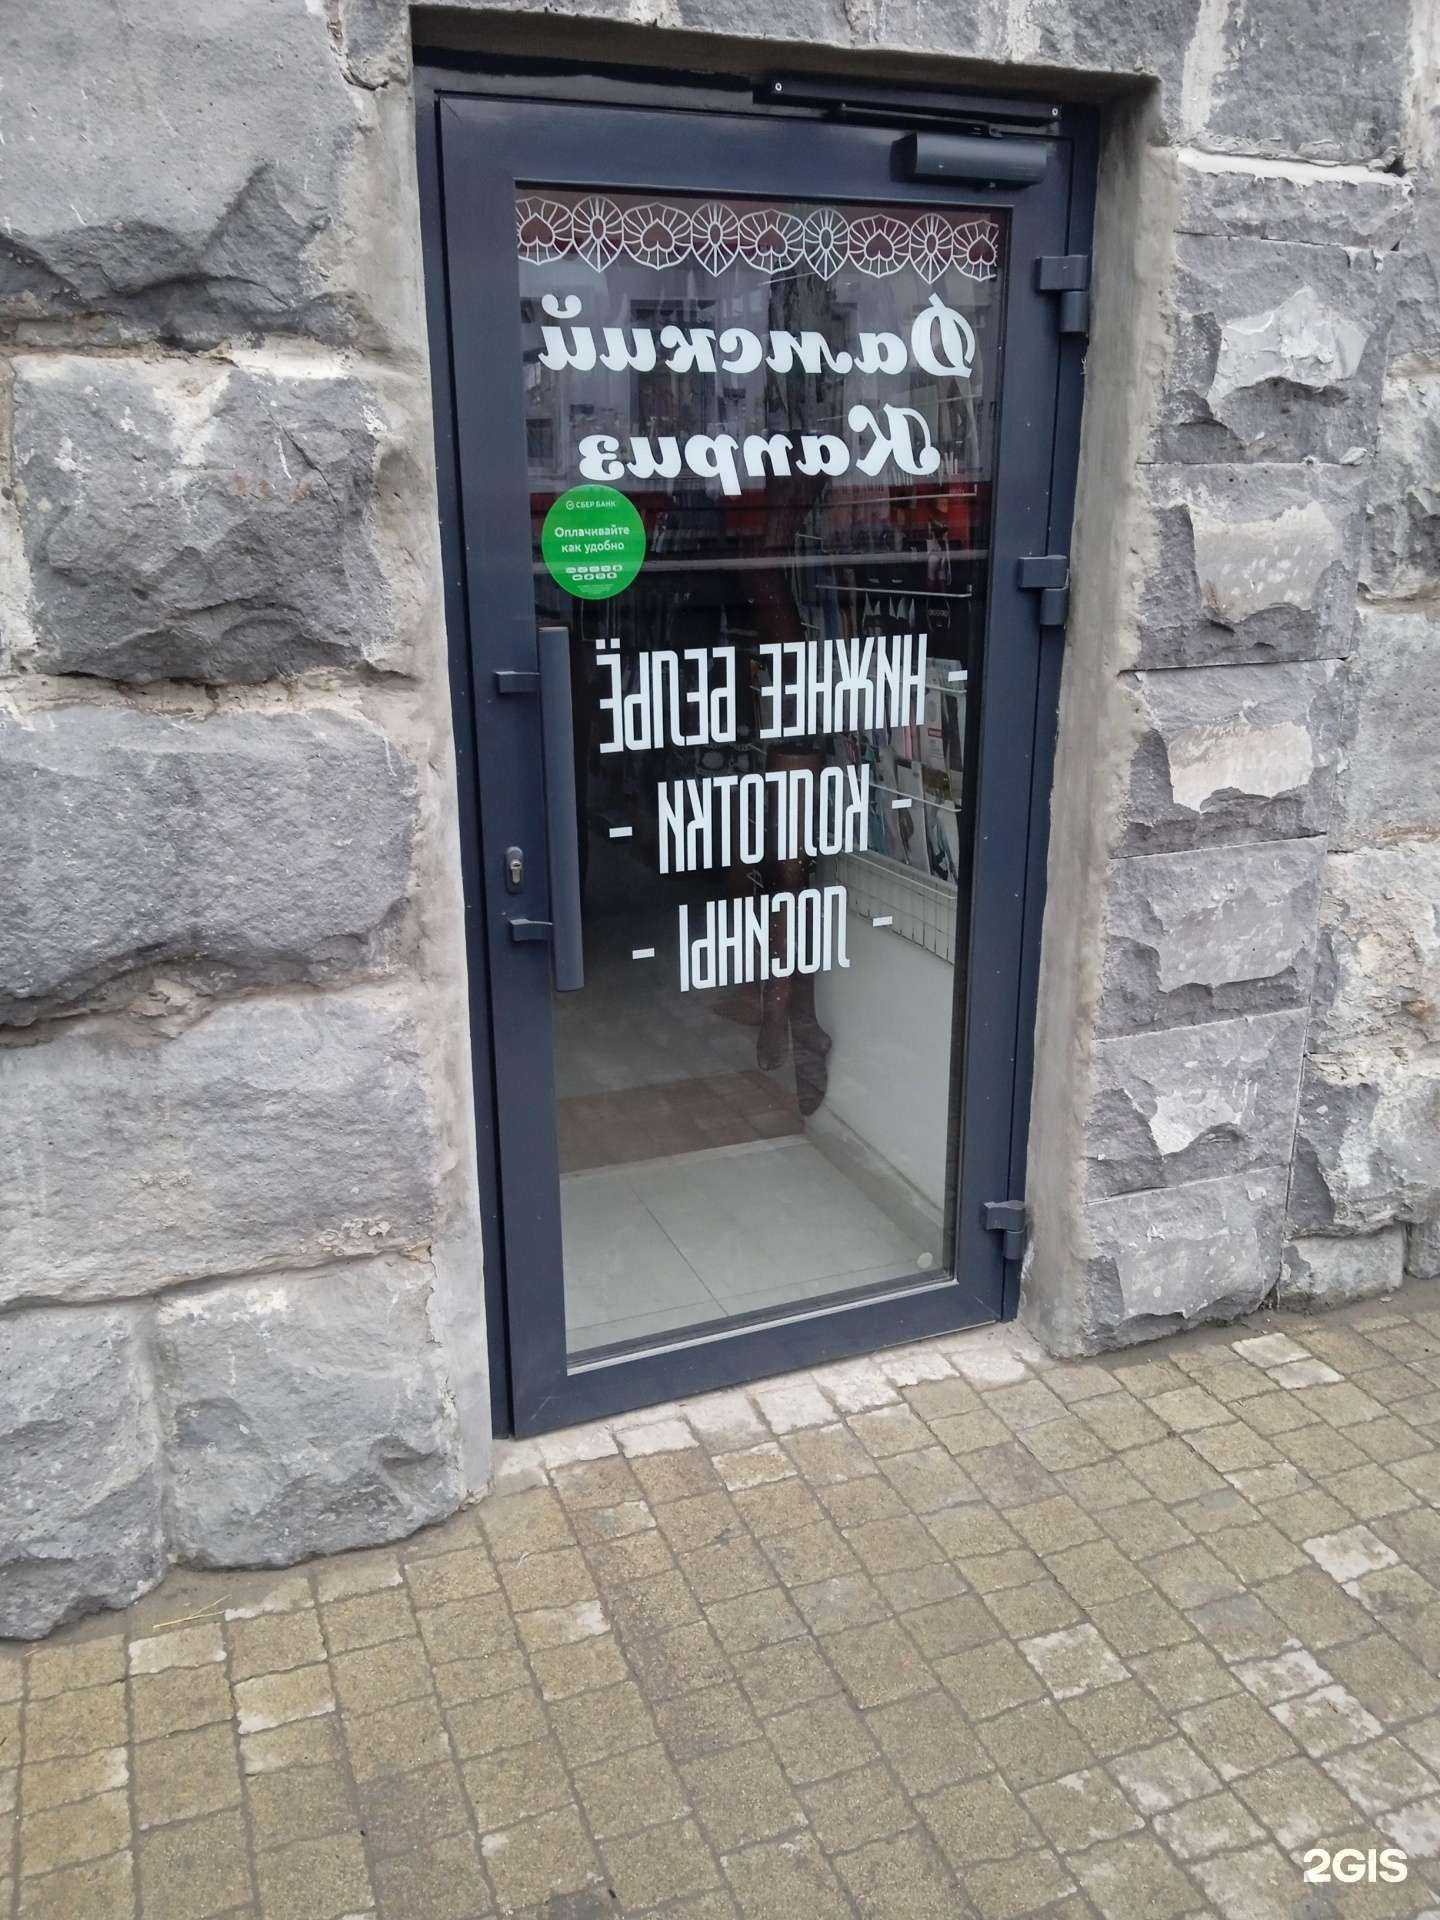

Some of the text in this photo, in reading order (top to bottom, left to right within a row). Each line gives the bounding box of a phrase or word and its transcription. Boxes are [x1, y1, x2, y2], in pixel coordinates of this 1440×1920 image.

[554, 524, 630, 537] Оплачивайте
[561, 539, 624, 553] как удобно
